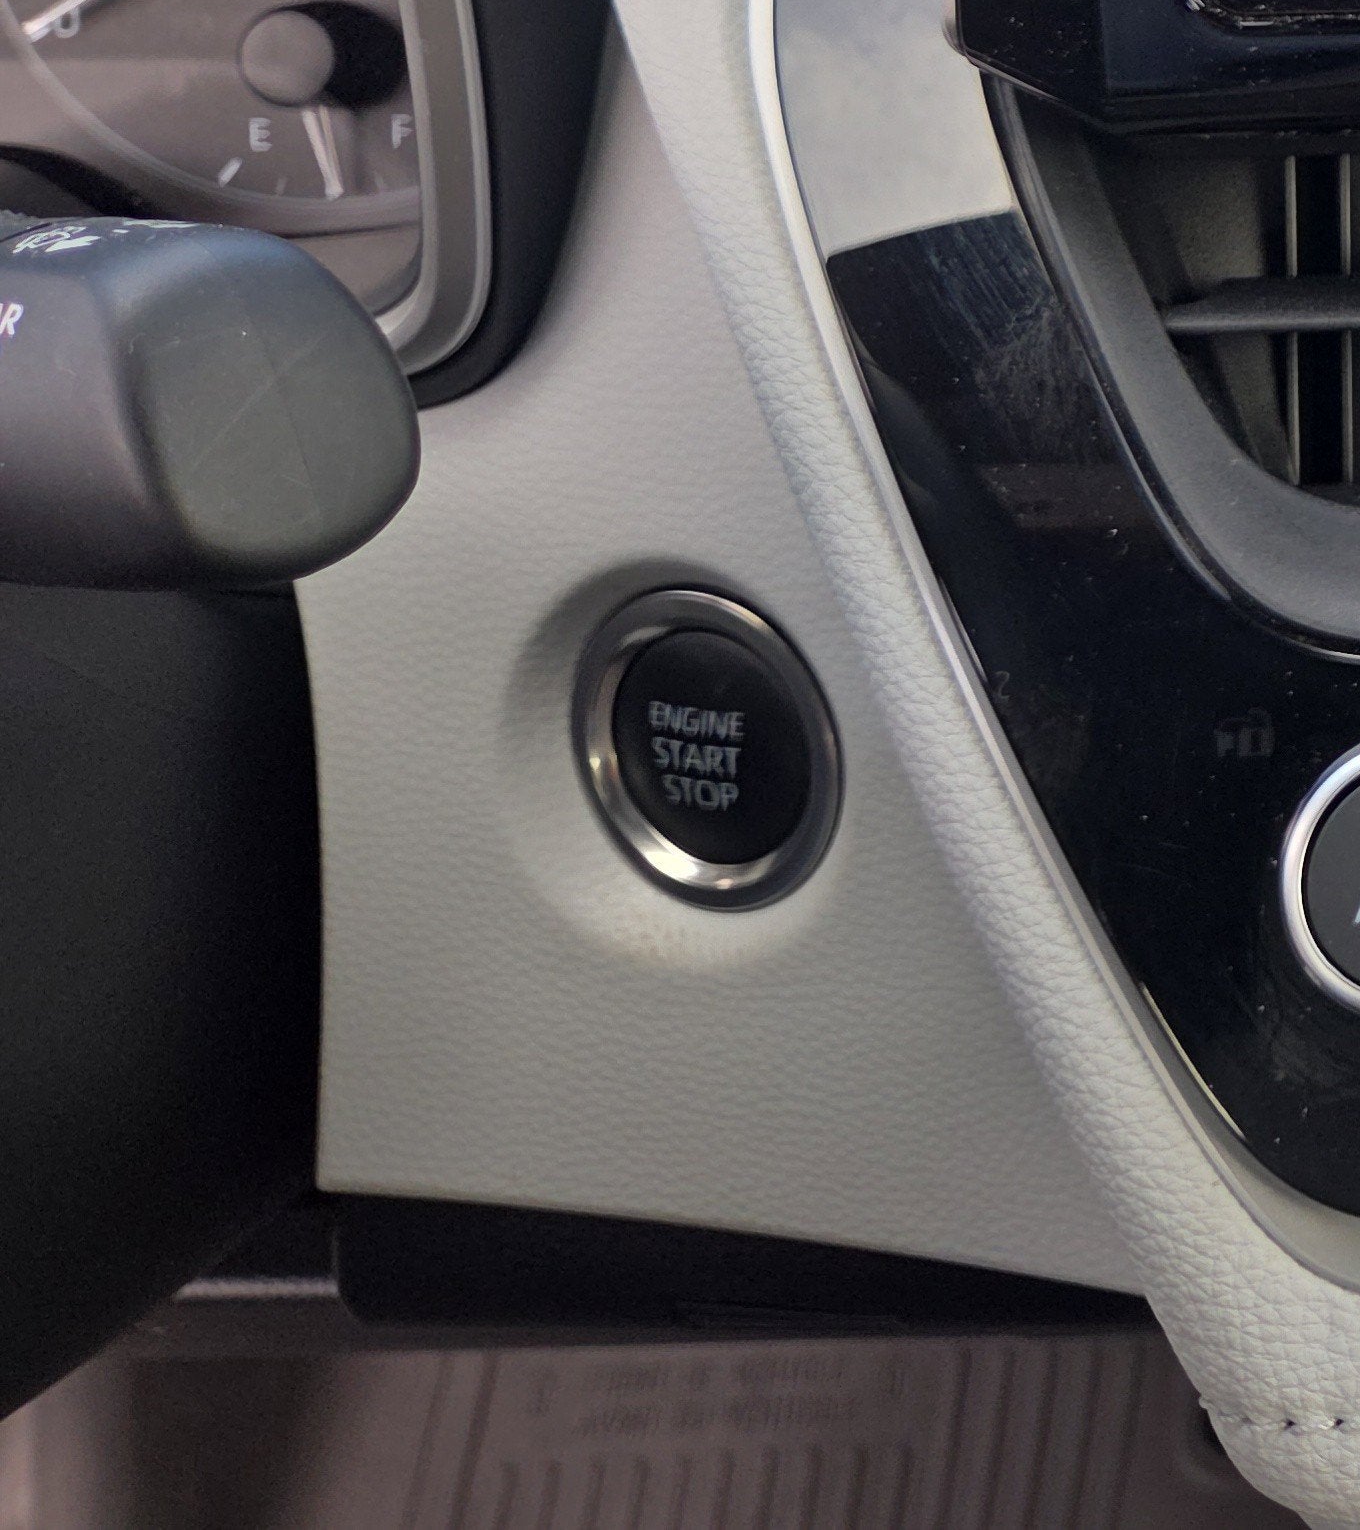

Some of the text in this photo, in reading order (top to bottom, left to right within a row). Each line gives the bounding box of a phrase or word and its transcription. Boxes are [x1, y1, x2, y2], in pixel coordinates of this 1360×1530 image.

[247, 117, 273, 153] E
[390, 113, 414, 149] F
[648, 700, 746, 740] ENGINE
[650, 735, 743, 775] START
[661, 774, 741, 812] STOP
